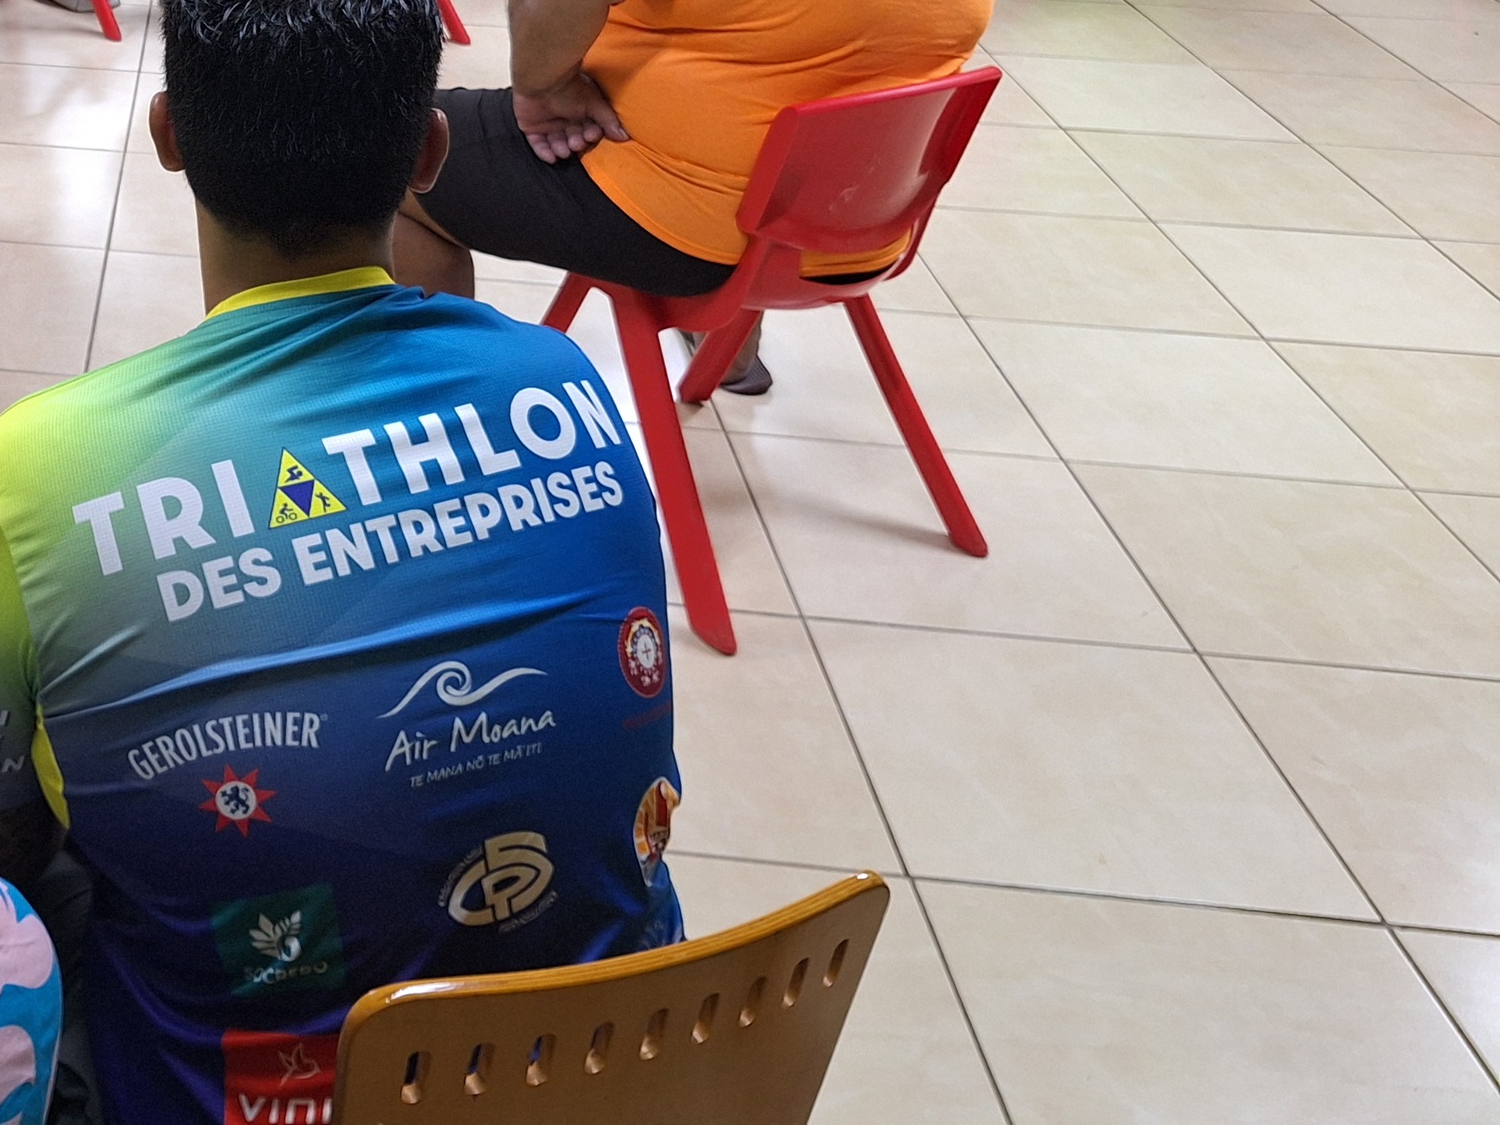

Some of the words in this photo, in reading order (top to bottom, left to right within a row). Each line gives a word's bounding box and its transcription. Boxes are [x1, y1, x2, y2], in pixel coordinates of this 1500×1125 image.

[156, 547, 282, 622] DES
[291, 461, 624, 586] ENTREPRISES
[128, 712, 320, 780] GEROLSTEINER
[385, 729, 438, 772] Air
[450, 710, 556, 753] Moana
[410, 775, 424, 788] TE
[426, 763, 463, 783] MANA
[488, 753, 501, 765] TE
